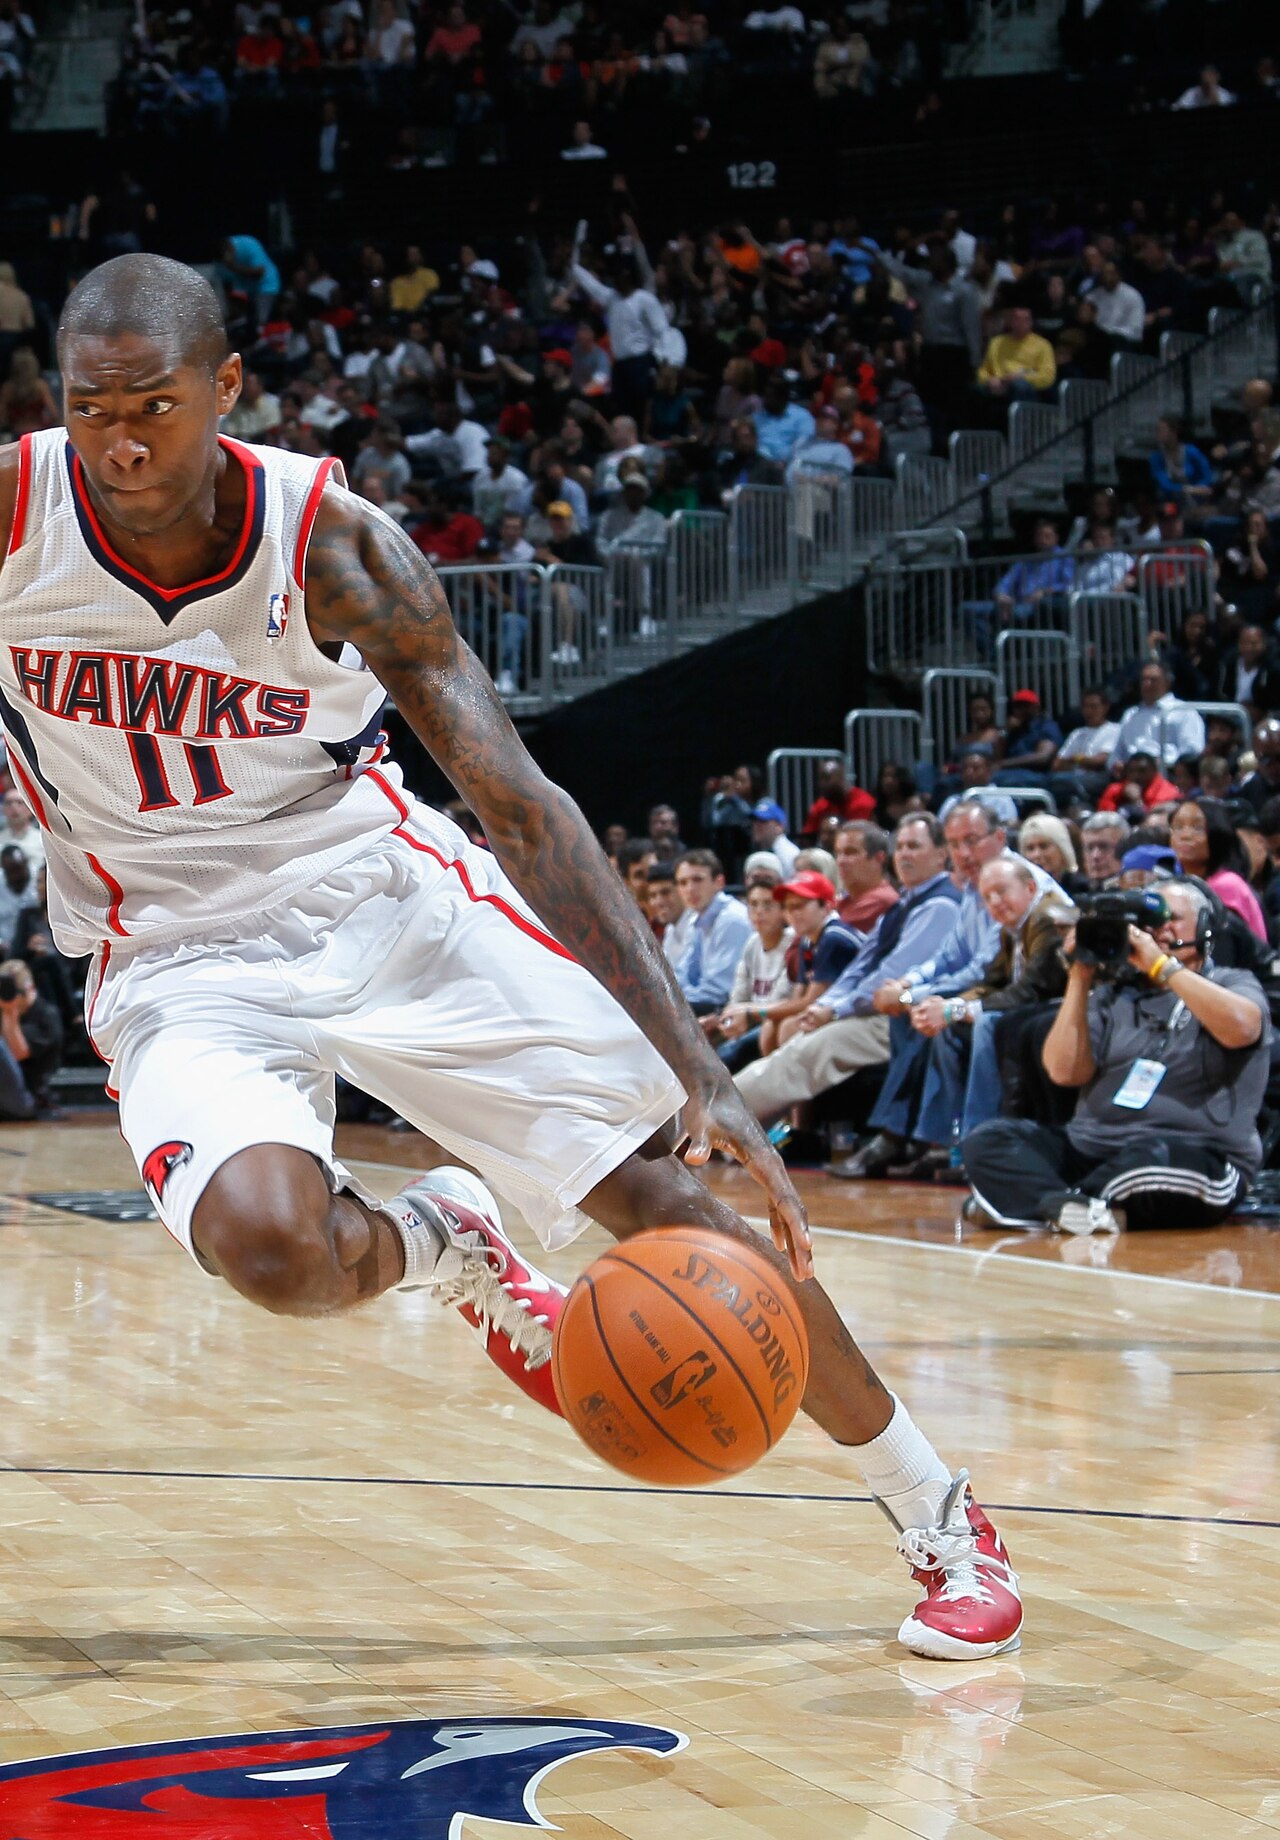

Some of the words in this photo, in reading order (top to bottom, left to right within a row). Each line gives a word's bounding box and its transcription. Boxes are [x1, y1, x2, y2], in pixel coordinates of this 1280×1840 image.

[727, 161, 777, 188] 122
[8, 645, 310, 740] HAWKS
[126, 731, 235, 813] 11
[672, 1252, 797, 1415] SPALDING
